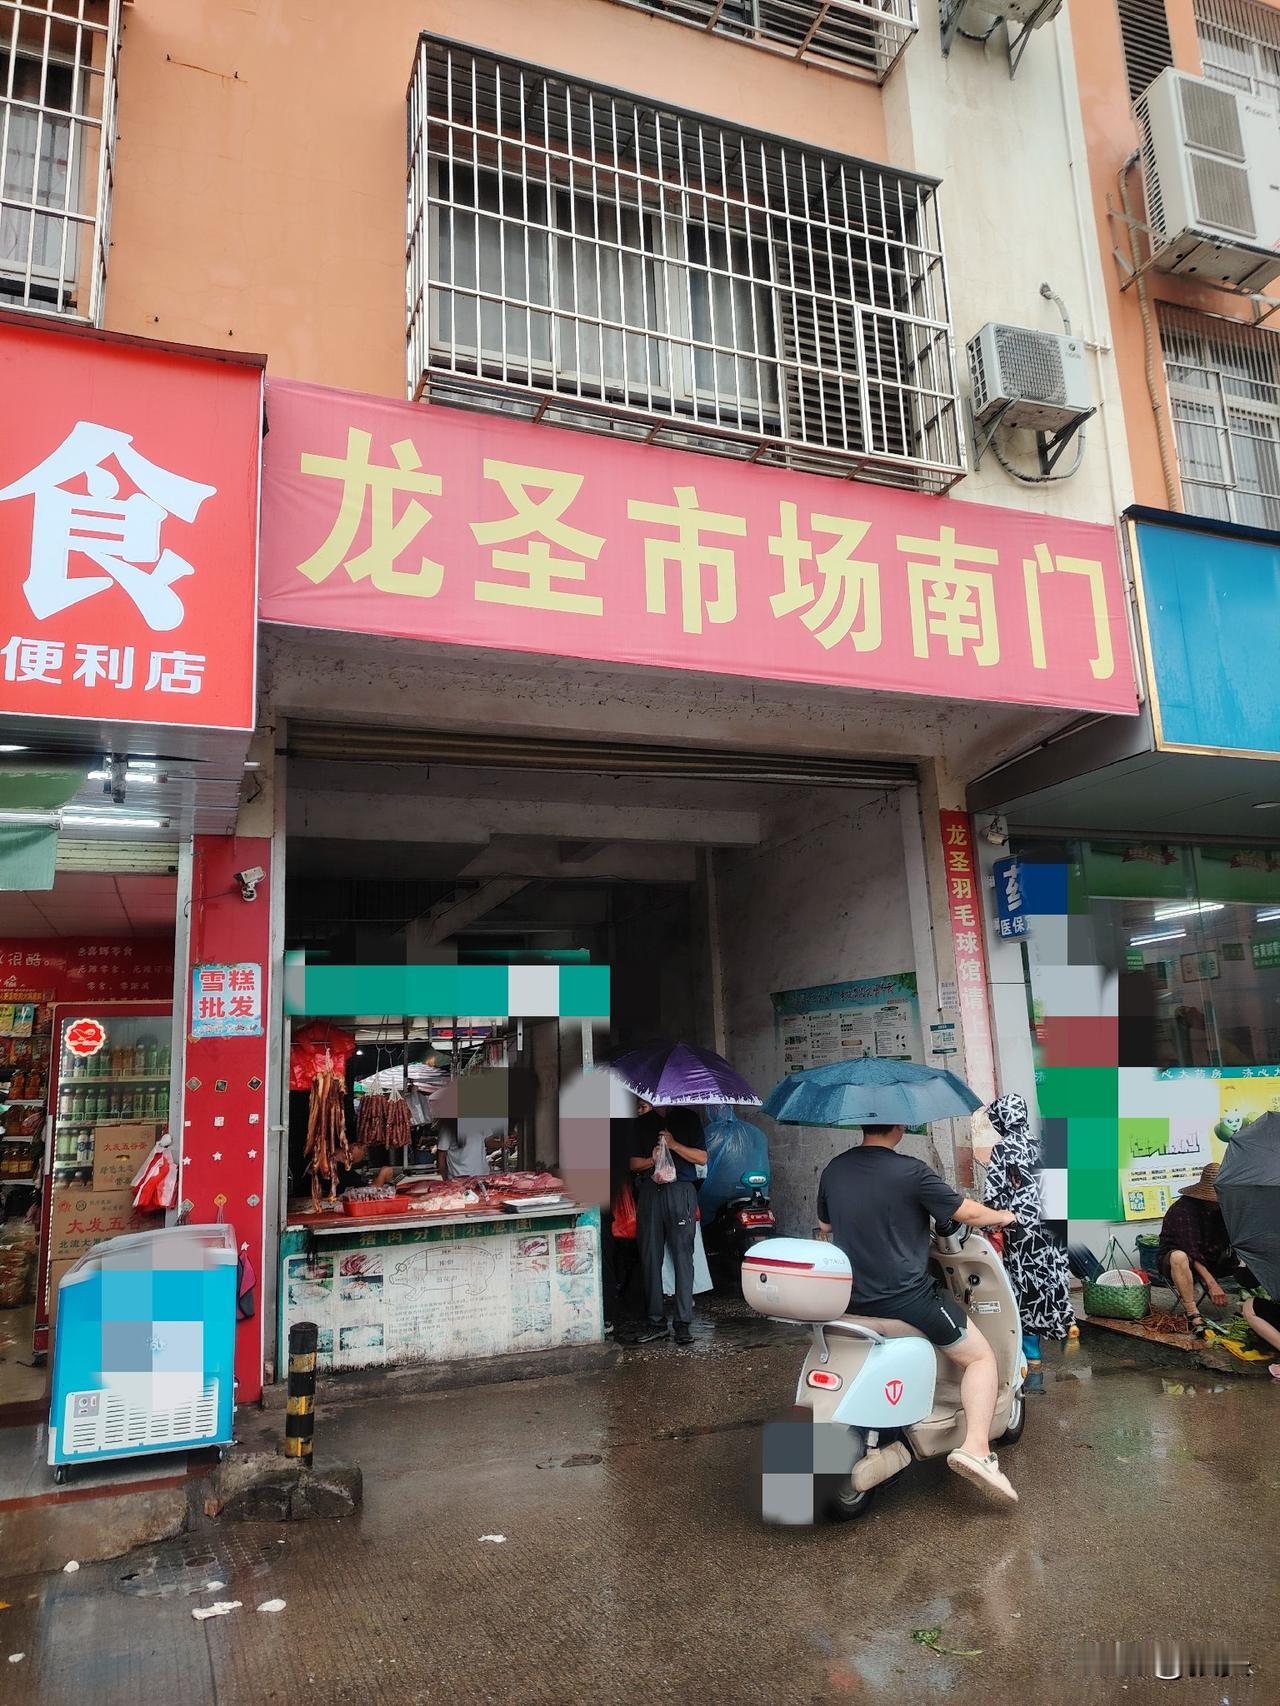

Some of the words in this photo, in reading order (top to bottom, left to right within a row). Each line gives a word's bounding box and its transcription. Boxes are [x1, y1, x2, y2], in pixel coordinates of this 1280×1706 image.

[0, 421, 217, 631] 食
[296, 427, 1114, 679] 龙圣市场南门
[1, 636, 206, 694] 便利店
[1000, 916, 1031, 936] 医保
[200, 970, 255, 992] 雪糕
[199, 996, 255, 1018] 批发
[1153, 1068, 1222, 1079] 心大药房
